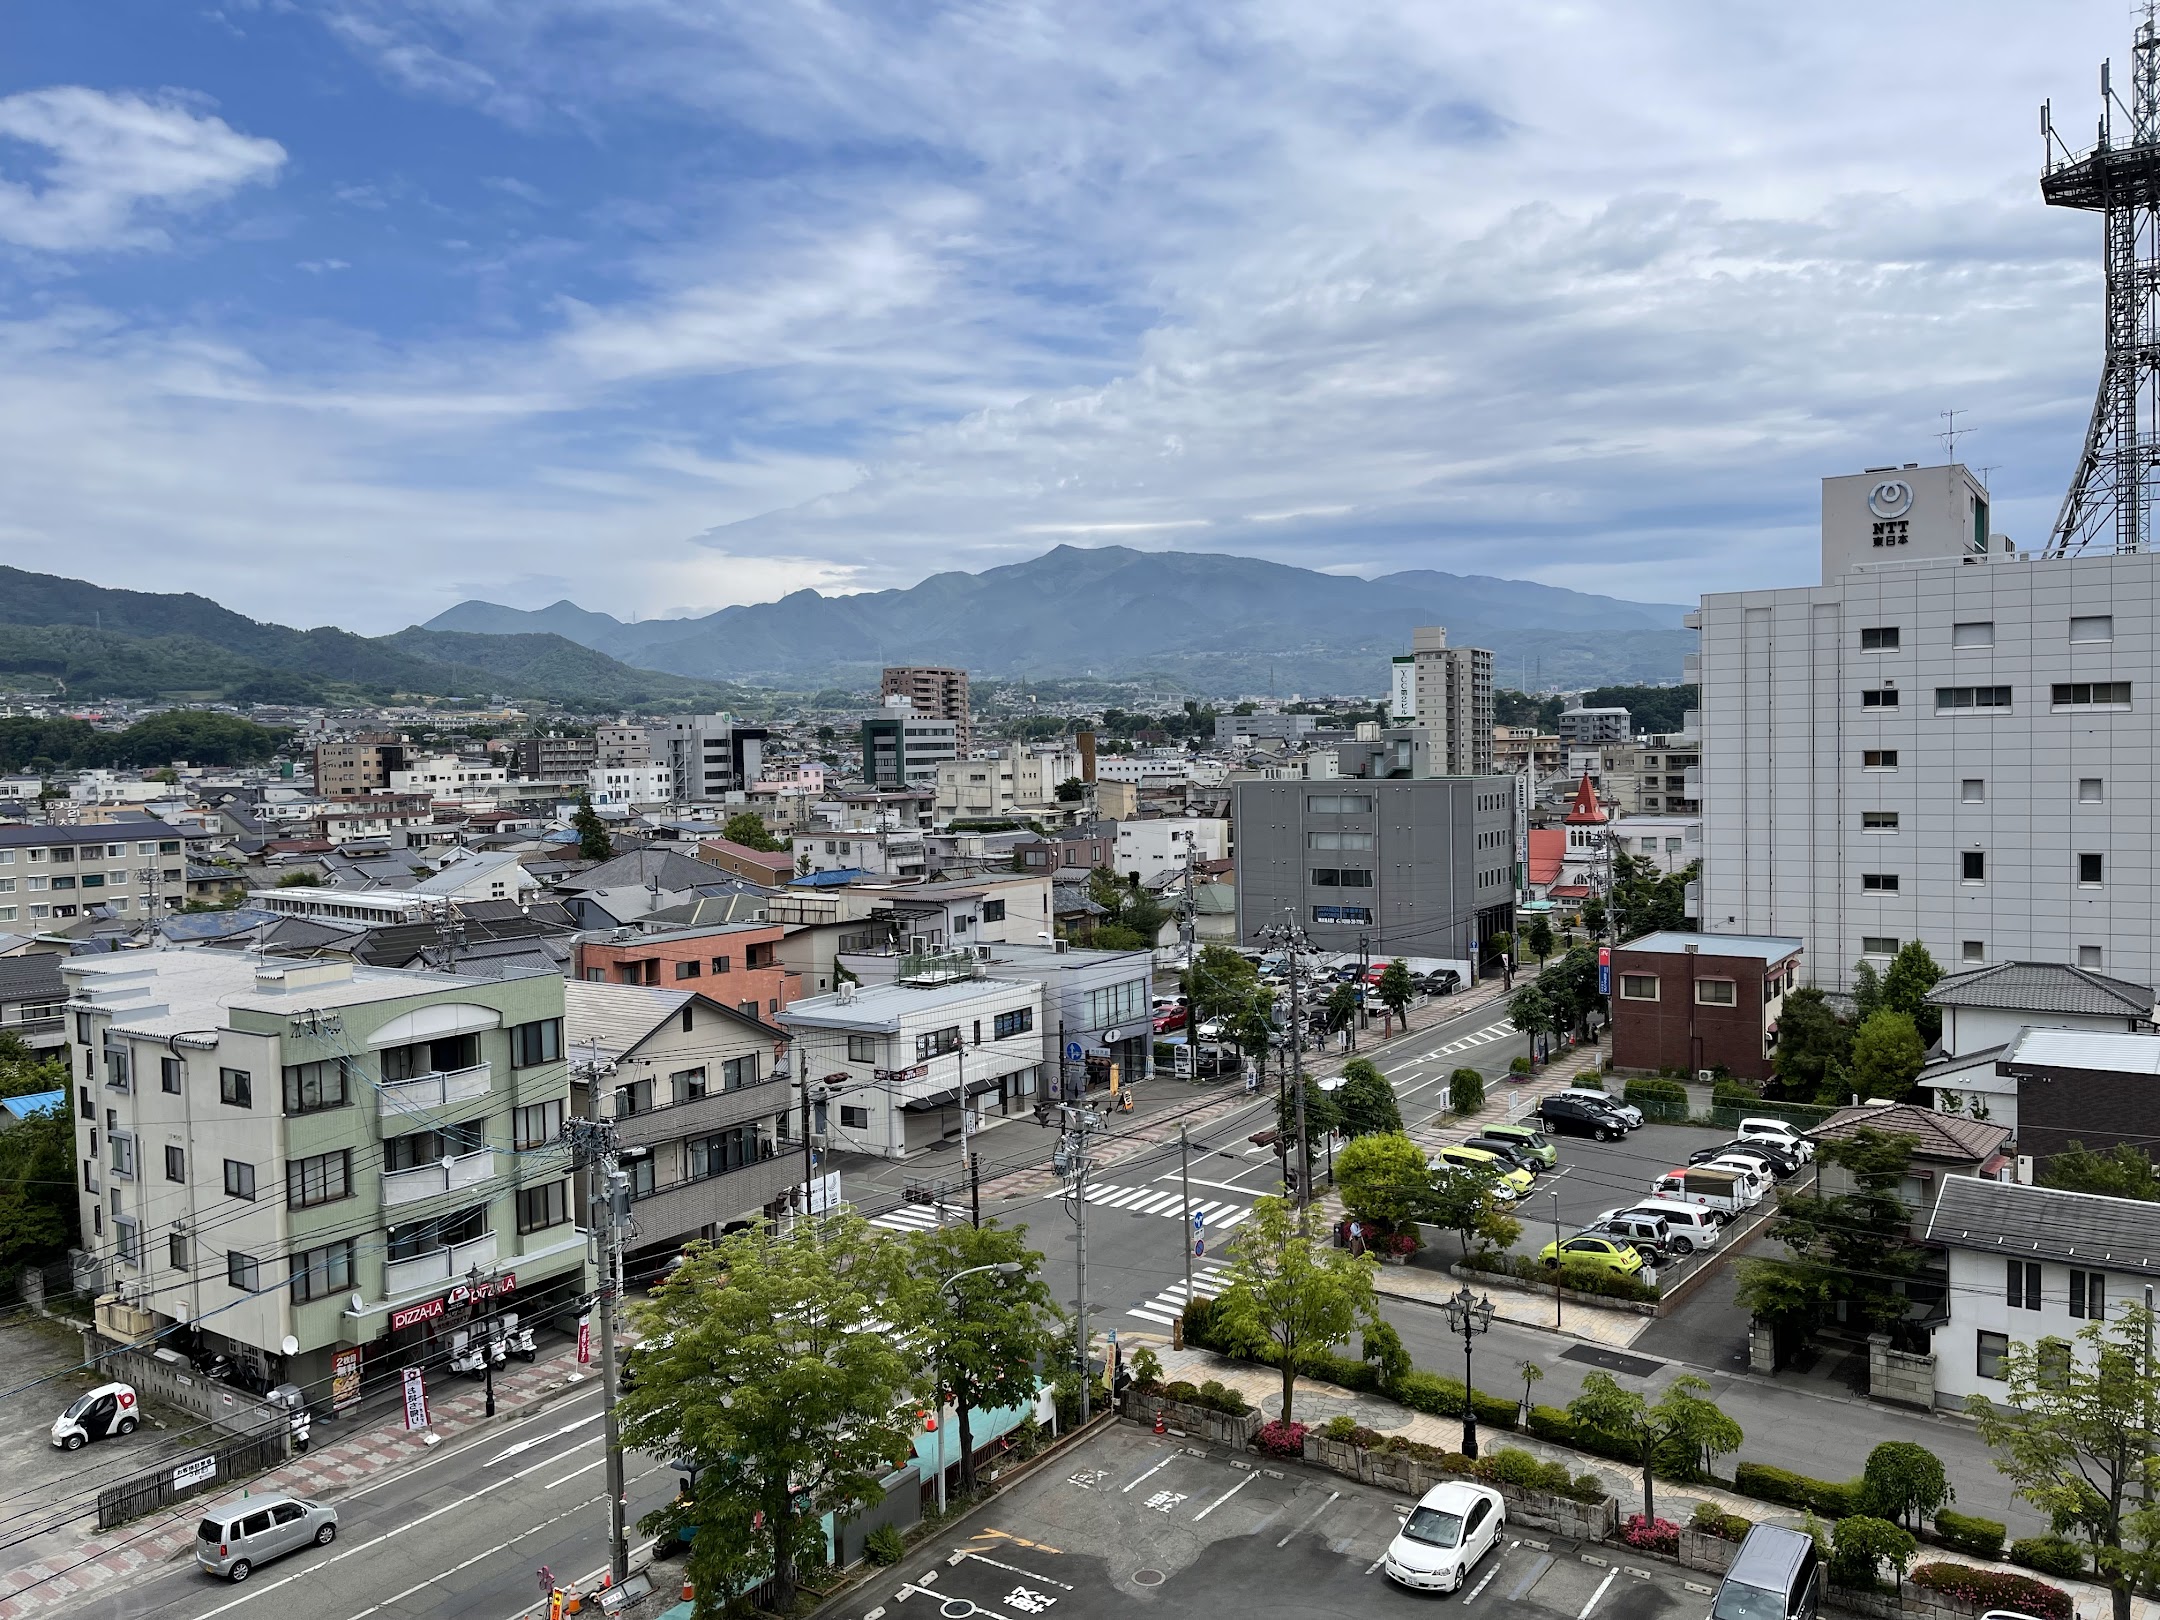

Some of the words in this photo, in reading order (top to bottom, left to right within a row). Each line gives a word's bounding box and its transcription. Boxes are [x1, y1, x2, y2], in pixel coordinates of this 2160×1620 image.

[1873, 520, 1909, 535] NTT
[1873, 534, 1908, 547] 東日本
[67, 809, 80, 817] 21
[395, 1302, 443, 1328] PIZZA-LA
[1003, 1585, 1058, 1614] 軽
